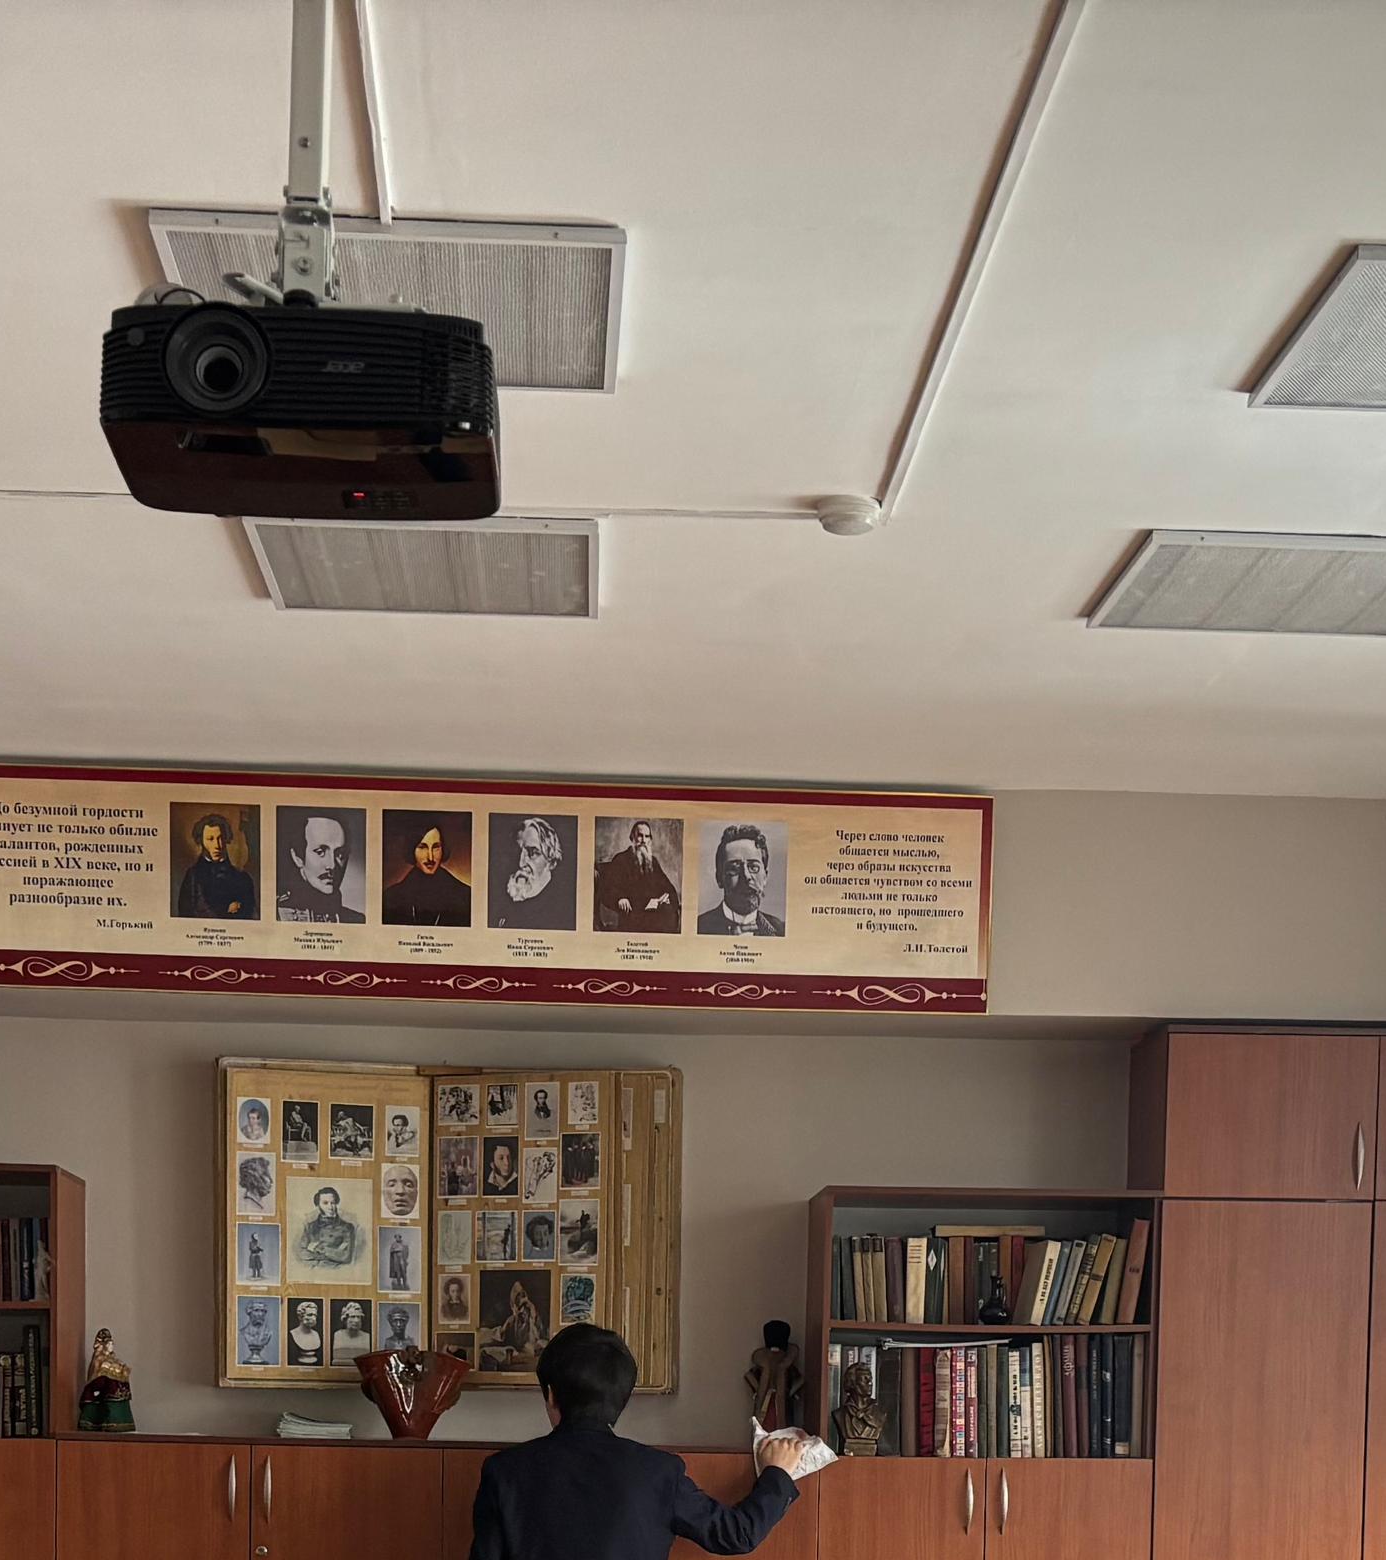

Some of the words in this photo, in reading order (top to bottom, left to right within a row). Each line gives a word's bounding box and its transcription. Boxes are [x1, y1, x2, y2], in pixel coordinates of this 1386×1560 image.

[14, 802, 77, 817] безумной
[82, 807, 143, 820] гордости
[38, 823, 52, 833] не
[58, 824, 105, 836] только
[109, 824, 158, 837] обилие
[836, 830, 866, 843] Через
[869, 833, 898, 842] слово
[902, 833, 944, 843] человек
[64, 841, 143, 854] рожденных
[839, 845, 889, 857] общается
[893, 849, 940, 860] мыслью,
[42, 859, 49, 868] в
[54, 857, 81, 869] XIX
[87, 861, 120, 872] веке,
[125, 861, 141, 872] но
[145, 862, 153, 872] и
[827, 861, 854, 872] через
[858, 860, 895, 873] образы
[899, 864, 951, 874] искусства
[23, 875, 113, 888] поражающее
[805, 876, 817, 884] он
[820, 875, 870, 886] общается
[873, 877, 923, 888] чувством
[927, 879, 937, 887] со
[941, 879, 972, 888] всеми
[9, 892, 102, 907] разнообразие
[107, 896, 127, 907] их.
[842, 891, 882, 902] людьми
[887, 893, 898, 901] не
[902, 892, 938, 903] только
[812, 905, 876, 917] настоящего,
[879, 907, 891, 915] но
[898, 907, 963, 919] прошедшего
[97, 918, 153, 930] М.Горький
[866, 920, 917, 933] будущего.
[903, 944, 968, 953] Л.Н.Толстой
